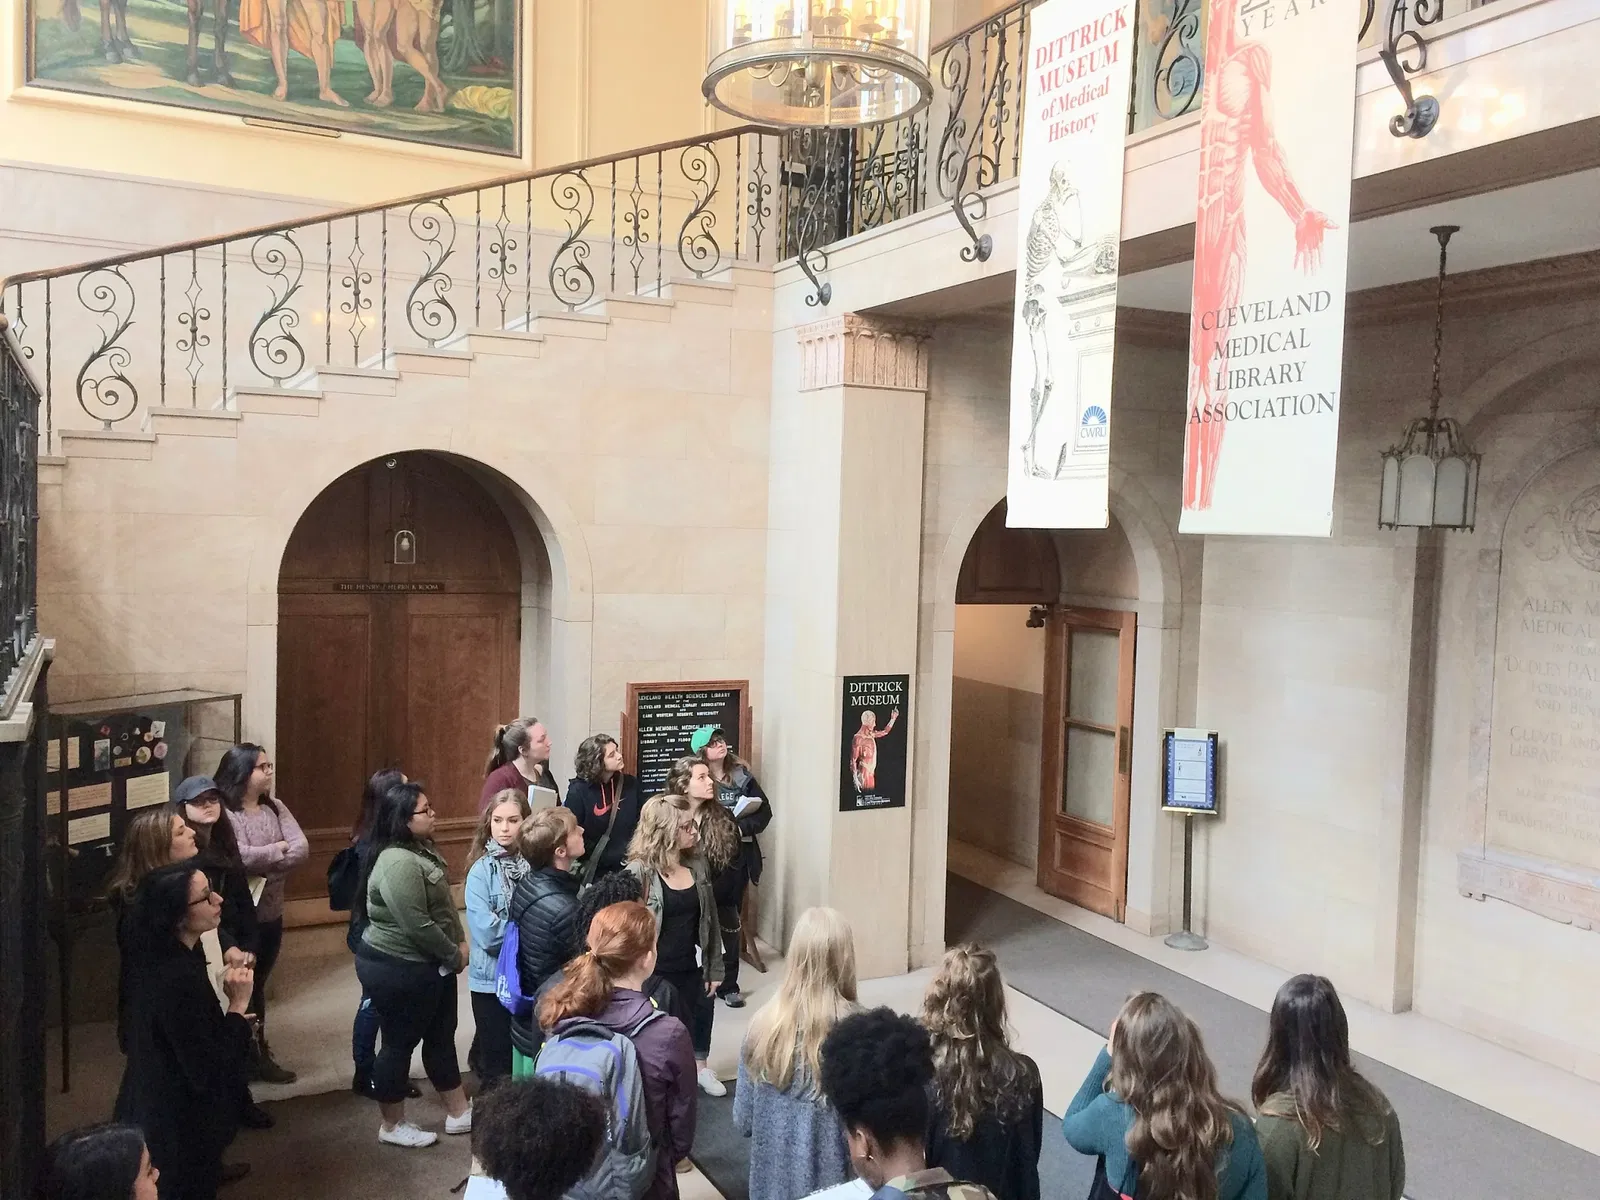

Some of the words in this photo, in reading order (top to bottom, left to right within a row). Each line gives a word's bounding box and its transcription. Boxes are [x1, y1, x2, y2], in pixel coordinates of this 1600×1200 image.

[1241, 0, 1327, 38] YEA
[1035, 4, 1128, 70] DITTRICK
[1038, 40, 1119, 96] MUSEUM
[1041, 98, 1056, 121] of
[1056, 75, 1110, 115] Medical
[1048, 112, 1099, 143] History
[1201, 290, 1331, 331] CLEVELAND
[1214, 328, 1311, 360] MEDICAL
[1215, 361, 1306, 391] LIBRARY
[1189, 392, 1336, 424] ASSOCIATION
[1081, 426, 1107, 439] CWRU
[1520, 617, 1596, 639] MEDICAL
[849, 681, 903, 693] DITTRICK
[851, 694, 900, 706] MUSEUM
